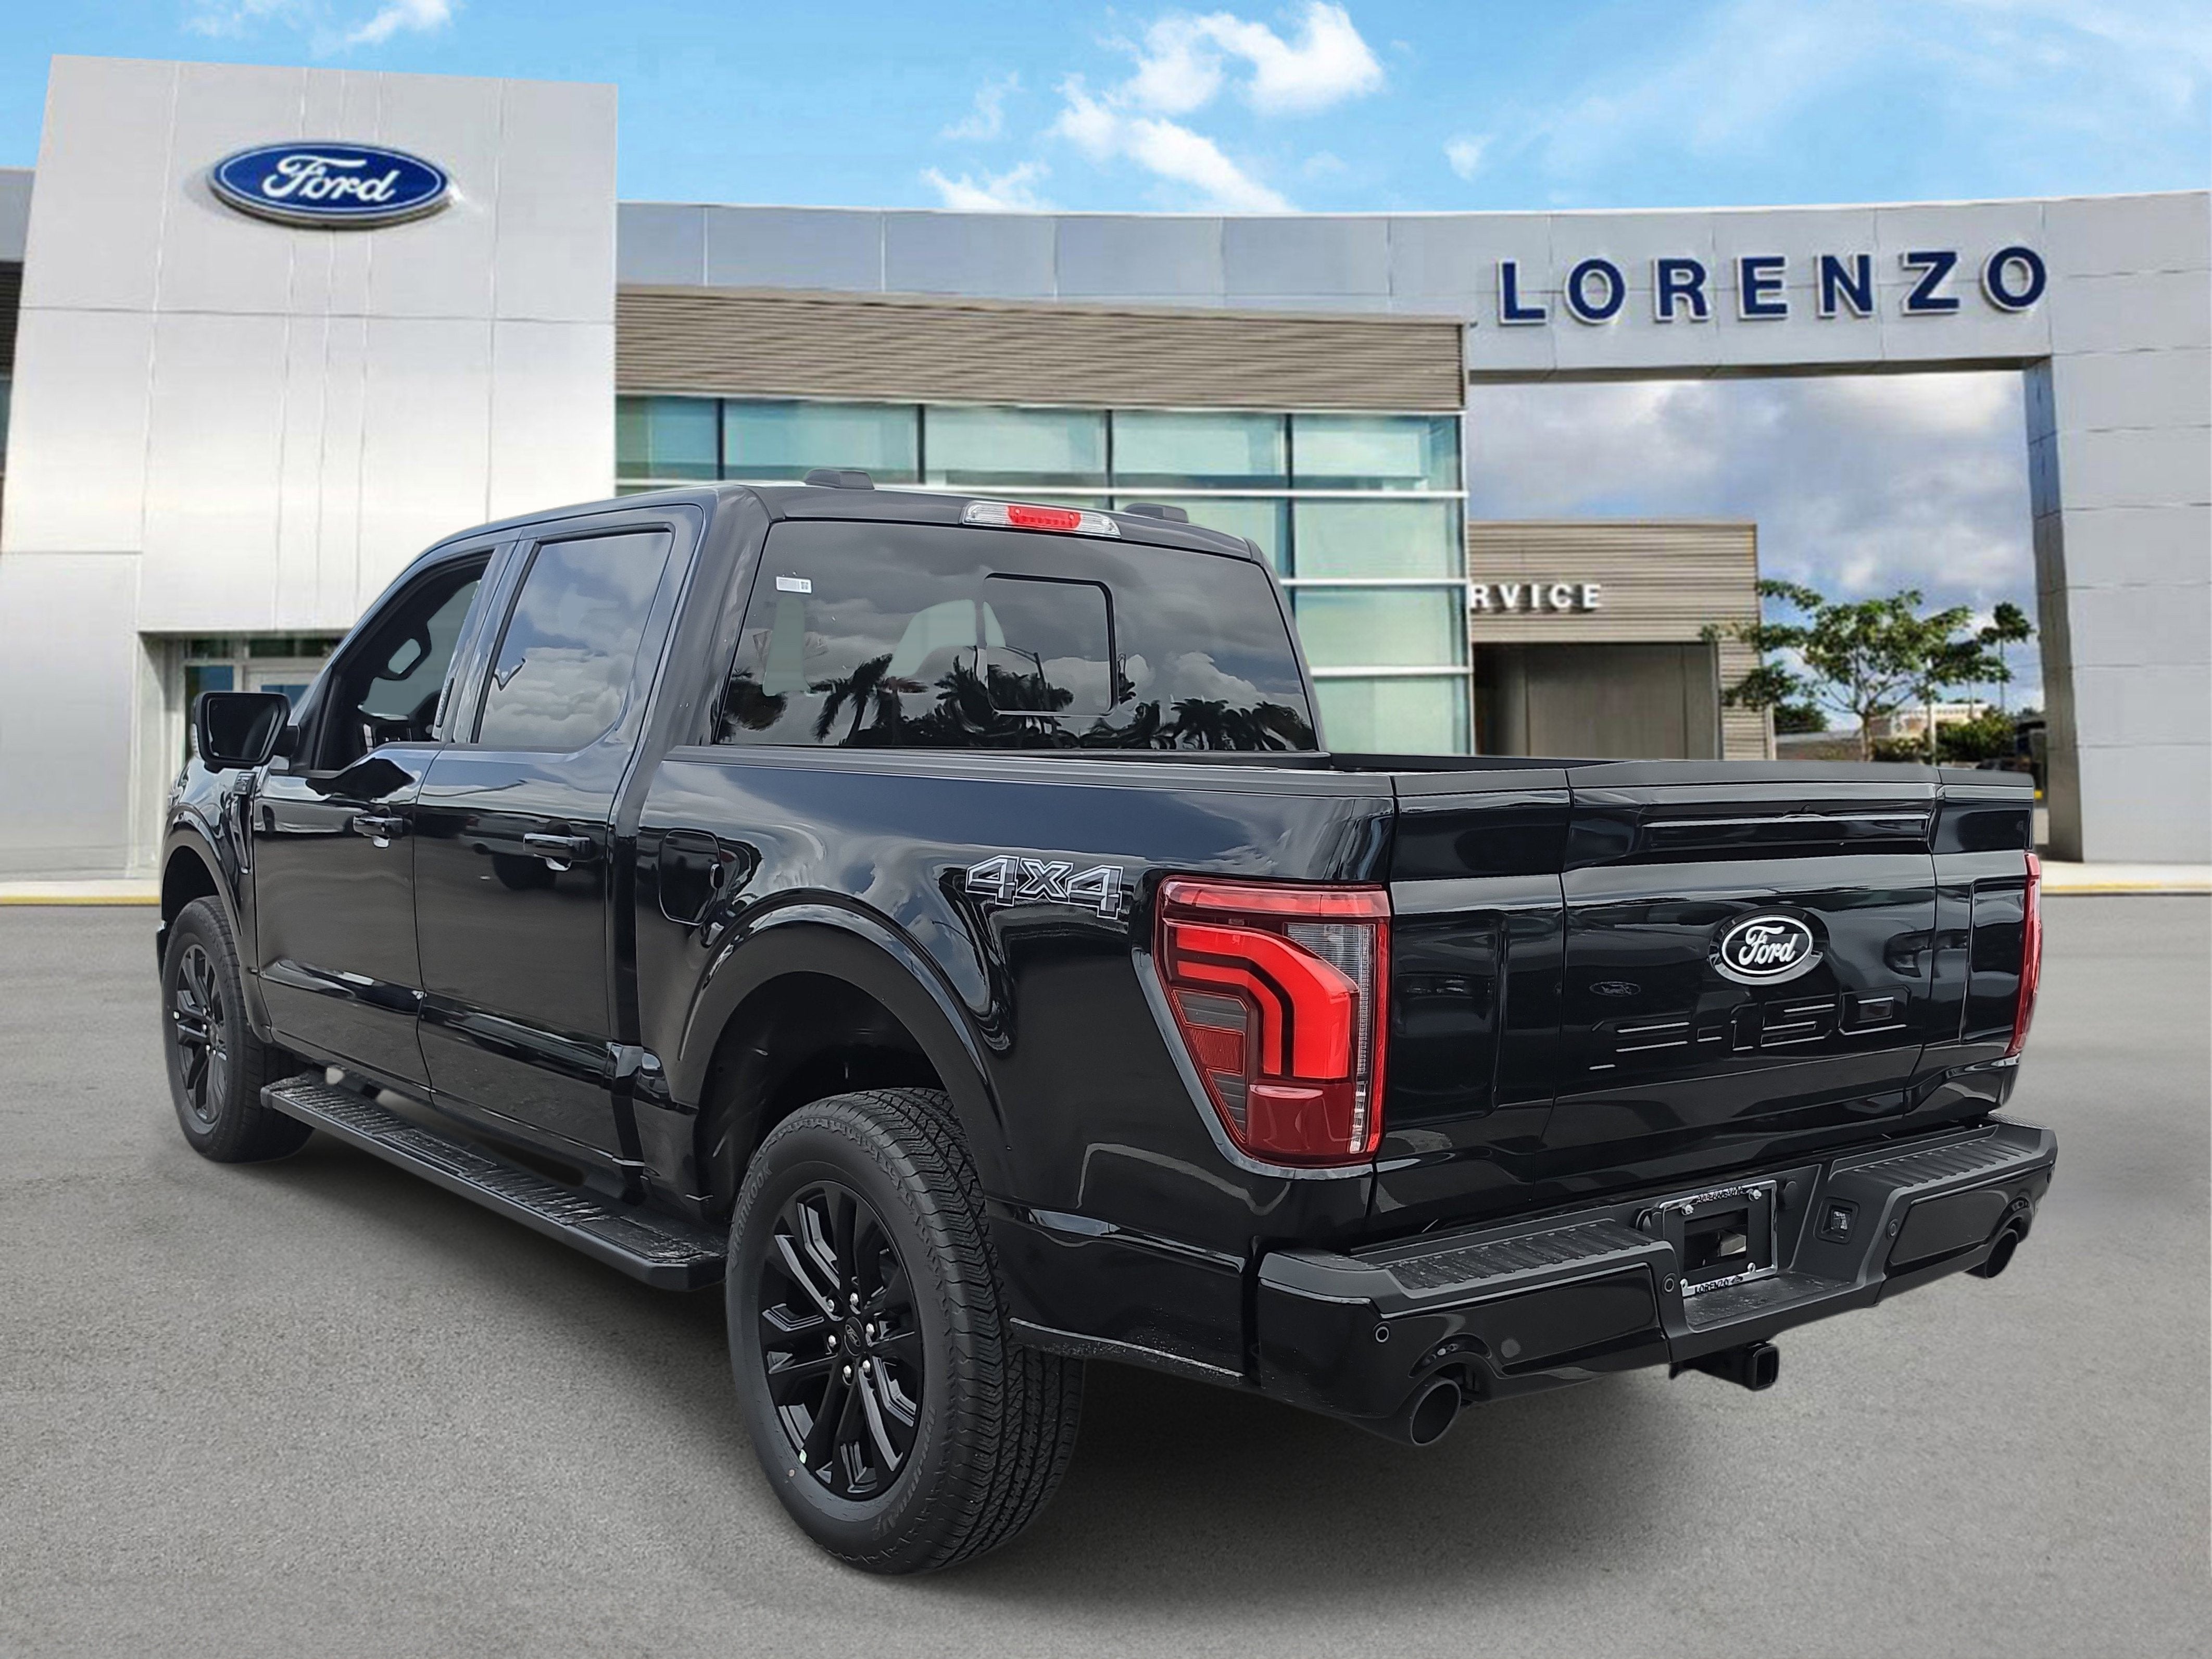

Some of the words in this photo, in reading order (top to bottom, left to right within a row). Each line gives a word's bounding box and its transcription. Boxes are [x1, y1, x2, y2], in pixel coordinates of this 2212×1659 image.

[262, 155, 400, 202] Ford
[1497, 246, 2047, 324] LORENZO
[1469, 583, 1602, 609] RVICE
[1738, 925, 1799, 965] Ford
